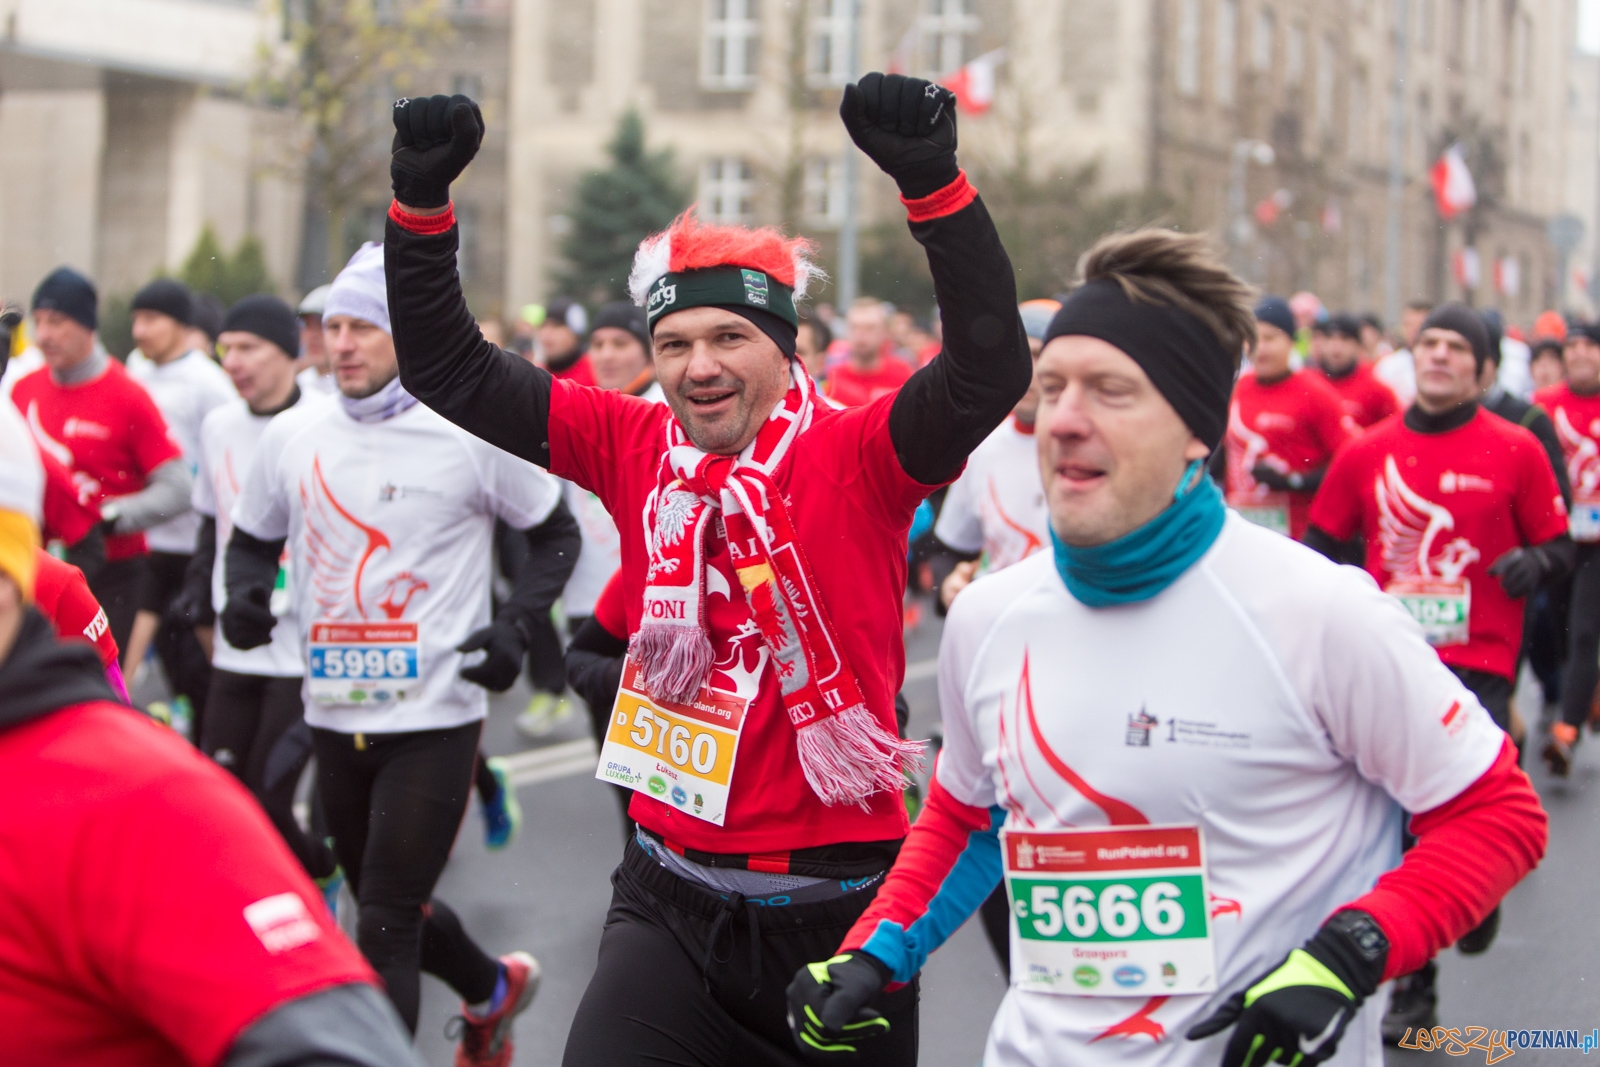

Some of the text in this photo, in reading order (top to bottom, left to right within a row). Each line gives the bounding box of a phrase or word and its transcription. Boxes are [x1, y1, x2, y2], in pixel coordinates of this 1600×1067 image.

[323, 648, 409, 678] 5996
[615, 705, 718, 774] D 5760
[605, 769, 635, 784] LUXMED
[607, 761, 631, 775] GRUPA
[656, 762, 678, 781] Łukasz
[1096, 844, 1188, 861] RunPoland.org
[1030, 881, 1186, 938] 5666
